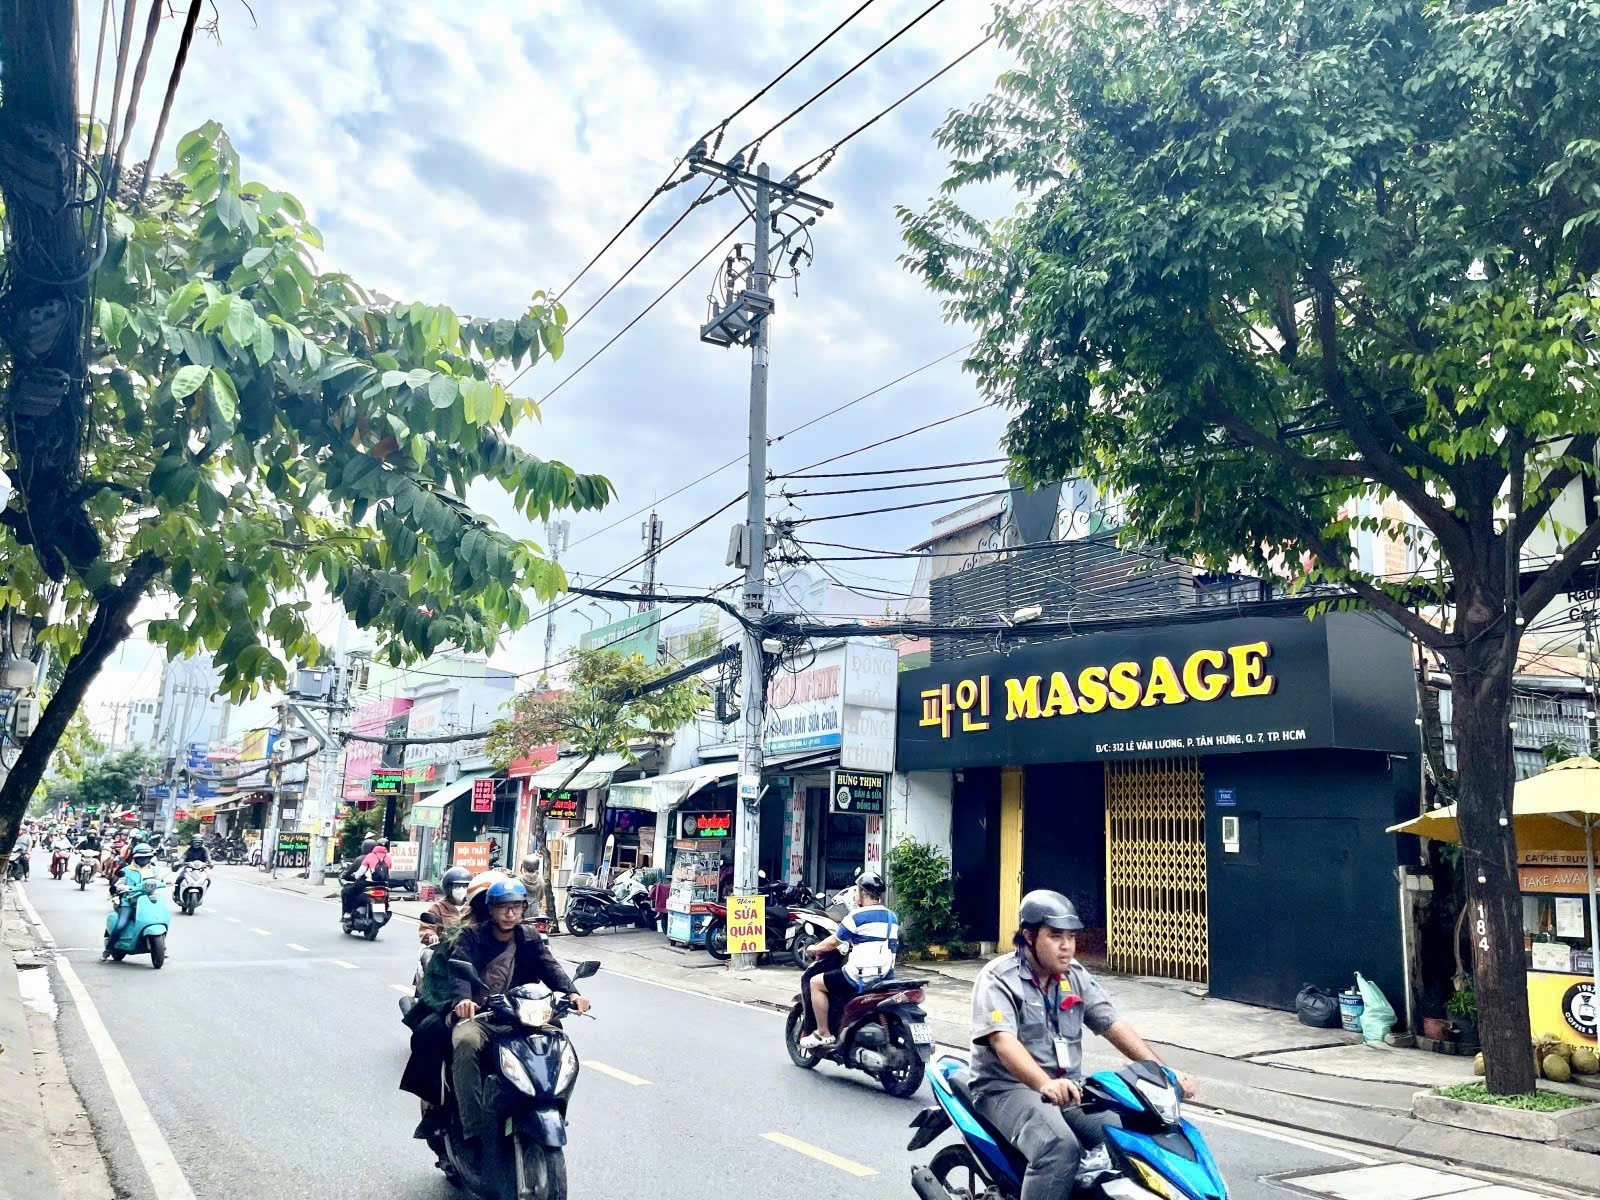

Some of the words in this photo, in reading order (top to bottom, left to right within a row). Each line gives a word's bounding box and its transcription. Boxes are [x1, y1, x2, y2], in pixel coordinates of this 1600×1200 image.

[1004, 641, 1275, 721] MASSAGE
[919, 675, 990, 738] 파인
[1112, 742, 1125, 752] 312
[1126, 740, 1135, 751] LÊ
[1136, 739, 1153, 751] VĂN
[1154, 737, 1185, 750] LƯƠNG,
[1187, 737, 1195, 747] P.
[1196, 734, 1213, 746] TÂN
[1216, 733, 1244, 746] HƯNG,
[1246, 732, 1256, 743] Q.
[1268, 731, 1281, 742] TP.
[1282, 730, 1306, 741] HCM
[859, 777, 882, 789] THỊNH
[866, 790, 871, 799] &
[279, 850, 294, 867] Tóc
[1522, 875, 1550, 887] TAKE
[1552, 873, 1590, 886] AWAY
[734, 905, 758, 920] SỬA
[1477, 904, 1490, 952] 184
[1565, 1011, 1586, 1033] COFFEE
